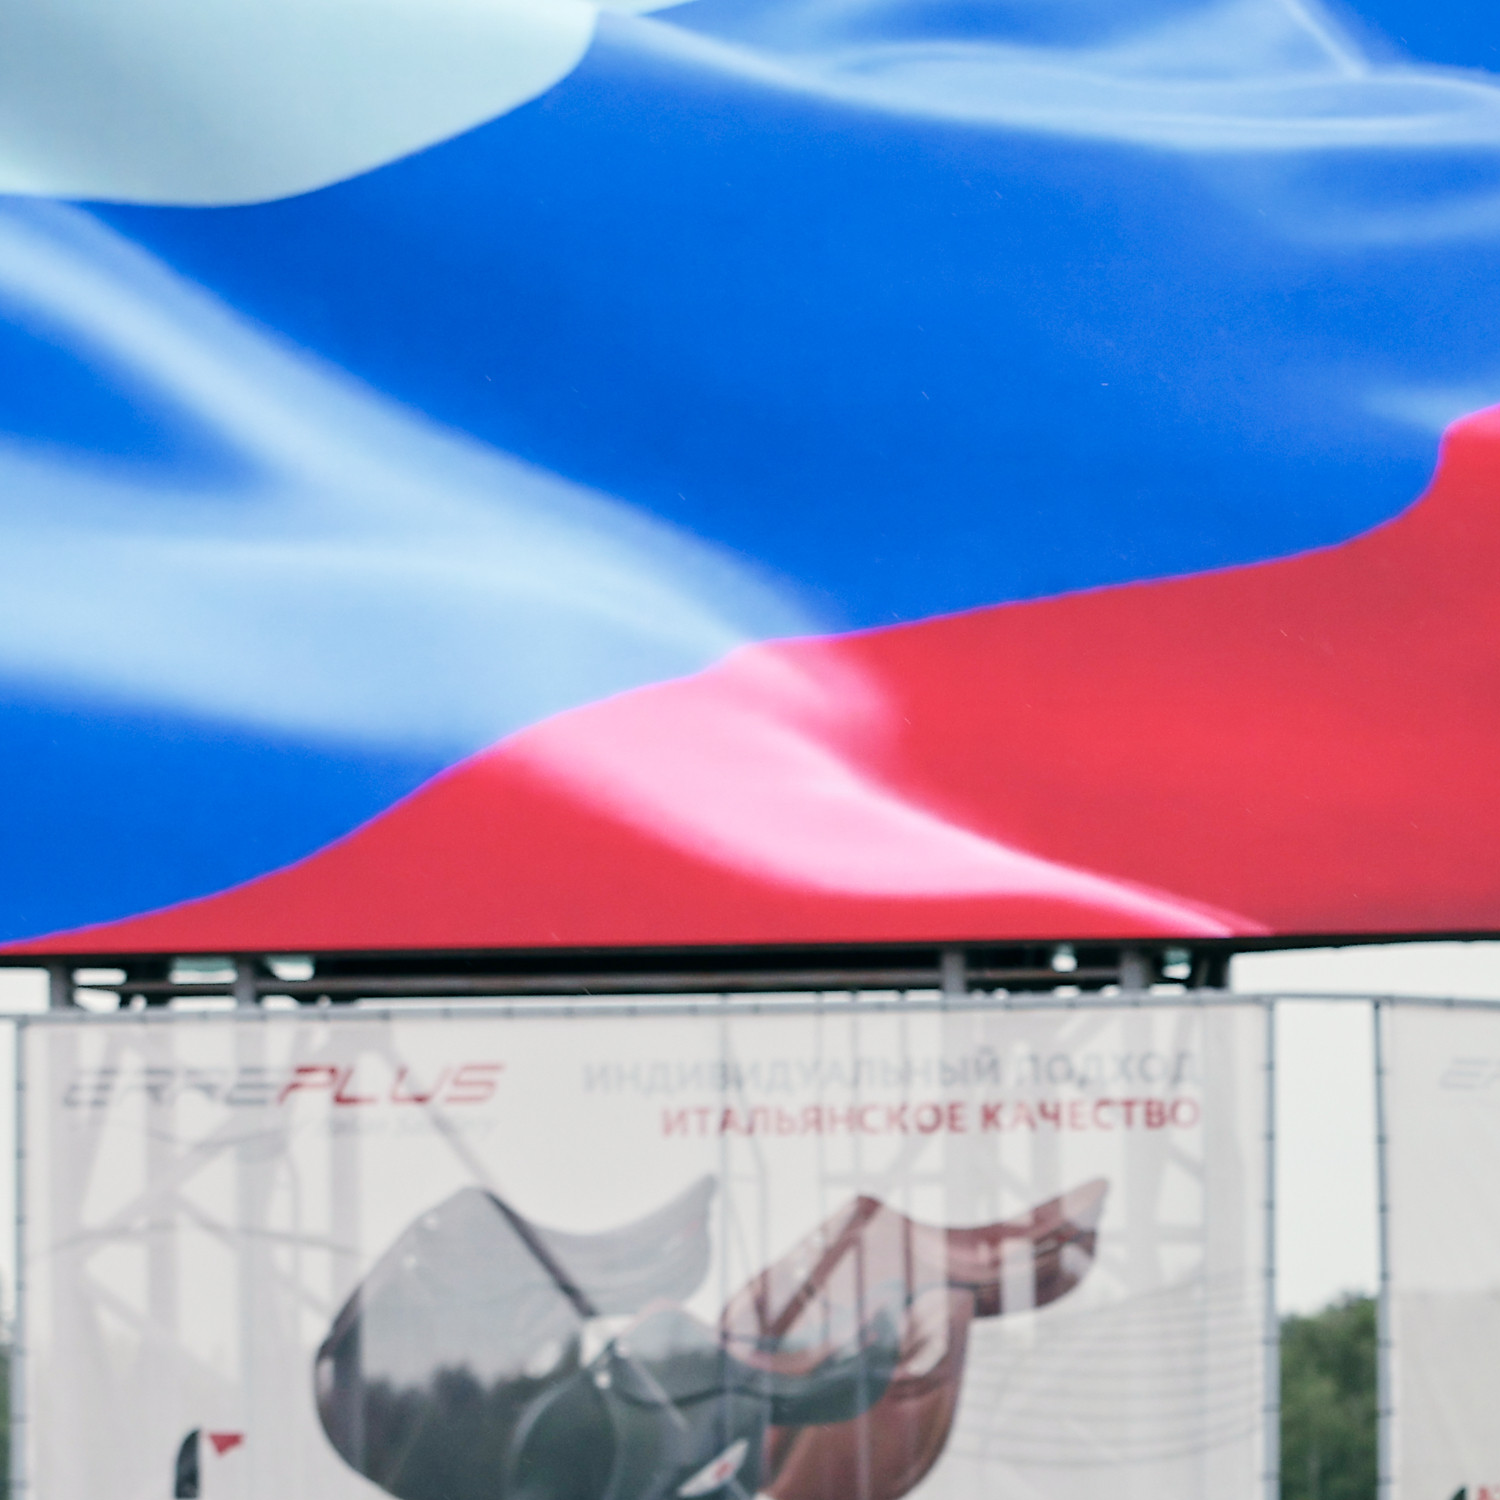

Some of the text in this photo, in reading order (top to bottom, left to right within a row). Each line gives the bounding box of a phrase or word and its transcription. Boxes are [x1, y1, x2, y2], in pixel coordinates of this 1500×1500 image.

[582, 1046, 1202, 1098] ИНДИВИДУАЛЬНЫЙ ПОДХОД
[660, 1096, 1201, 1140] ИТАЛЬЯНСКОЕ КАЧЕСТВО
